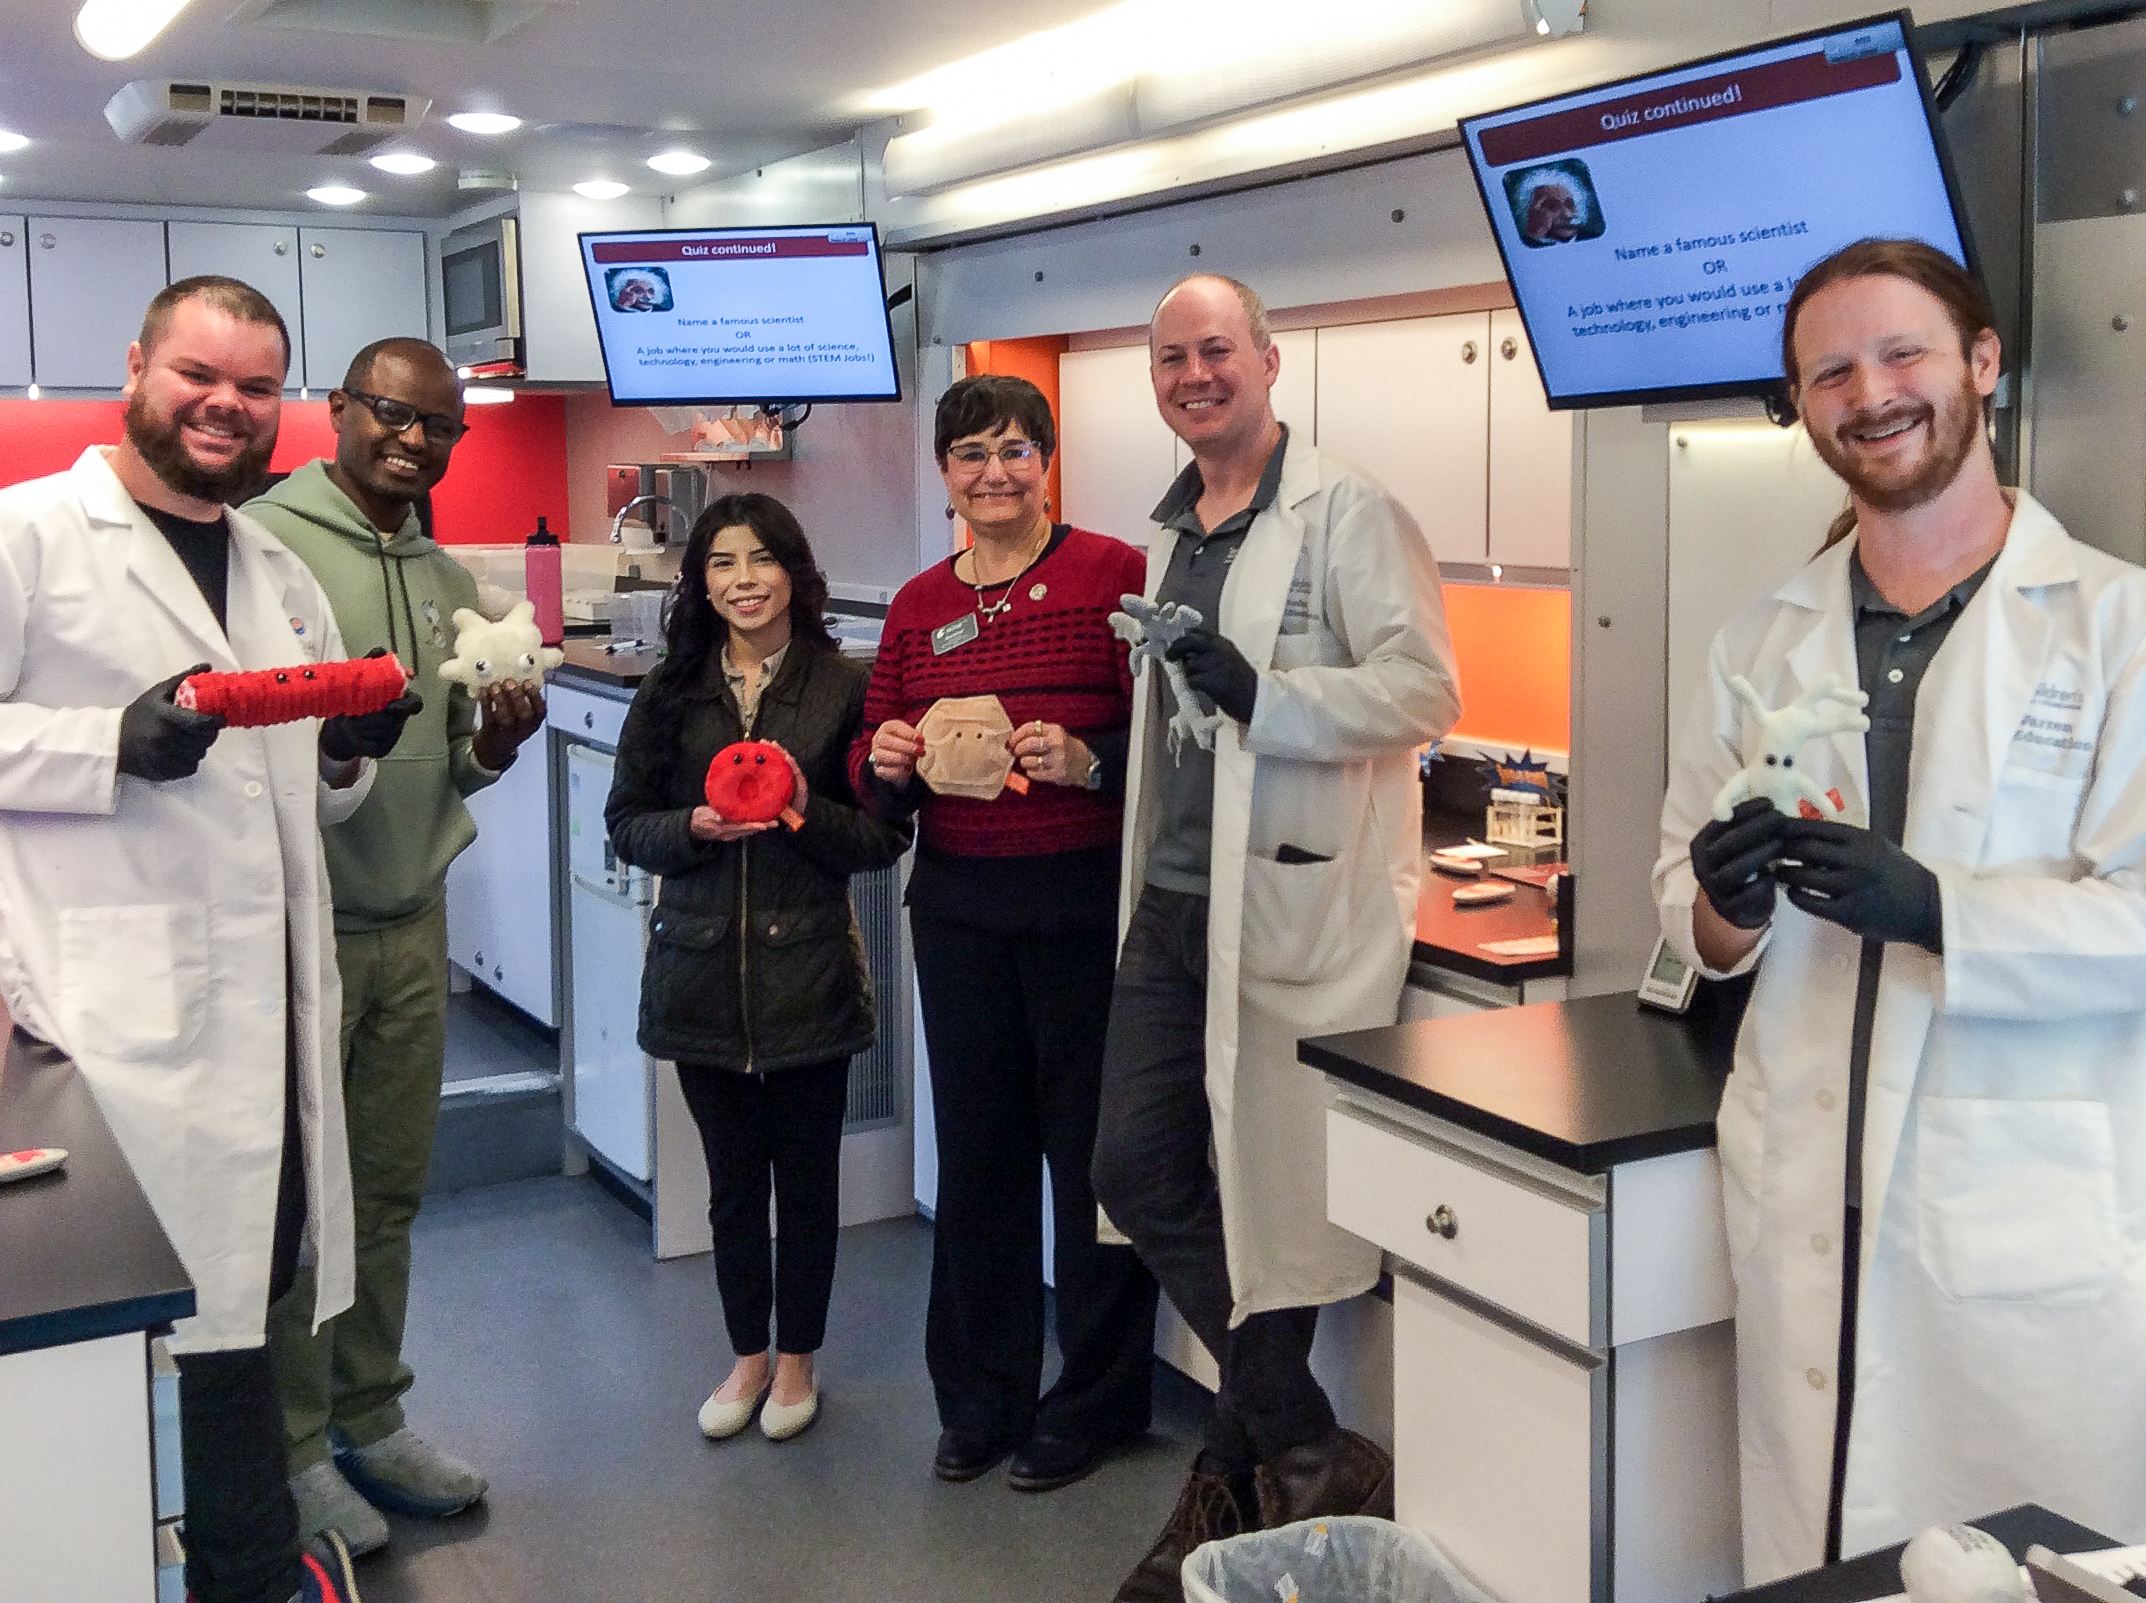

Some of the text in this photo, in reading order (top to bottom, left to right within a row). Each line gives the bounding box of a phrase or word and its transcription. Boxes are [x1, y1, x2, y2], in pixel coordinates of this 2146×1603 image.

[1600, 84, 1742, 130] Quiz continued!
[1614, 221, 1808, 261] Name a famous scientist
[681, 242, 776, 256] Quiz continued!
[1703, 259, 1728, 275] OR
[1568, 305, 1578, 317] A
[1581, 301, 1603, 319] job
[1606, 299, 1652, 313] where
[1655, 294, 1684, 309] you
[1688, 283, 1737, 301] would
[1740, 283, 1769, 296] use
[1773, 281, 1784, 292] a
[677, 318, 708, 327] Name
[720, 317, 759, 325] famous
[761, 316, 804, 325] scientist
[1572, 319, 1656, 337] technology,
[1659, 306, 1751, 328] engineering
[1755, 305, 1770, 316] or
[735, 331, 751, 339] OR
[647, 347, 663, 356] job
[666, 346, 698, 354] where
[701, 347, 720, 355] you
[722, 345, 754, 353] would
[787, 344, 801, 352] lot
[804, 343, 814, 351] of
[818, 343, 860, 352] science,
[638, 358, 698, 367] technology,
[700, 357, 762, 367] engineering
[778, 355, 805, 363] math
[808, 354, 841, 363] (STEM
